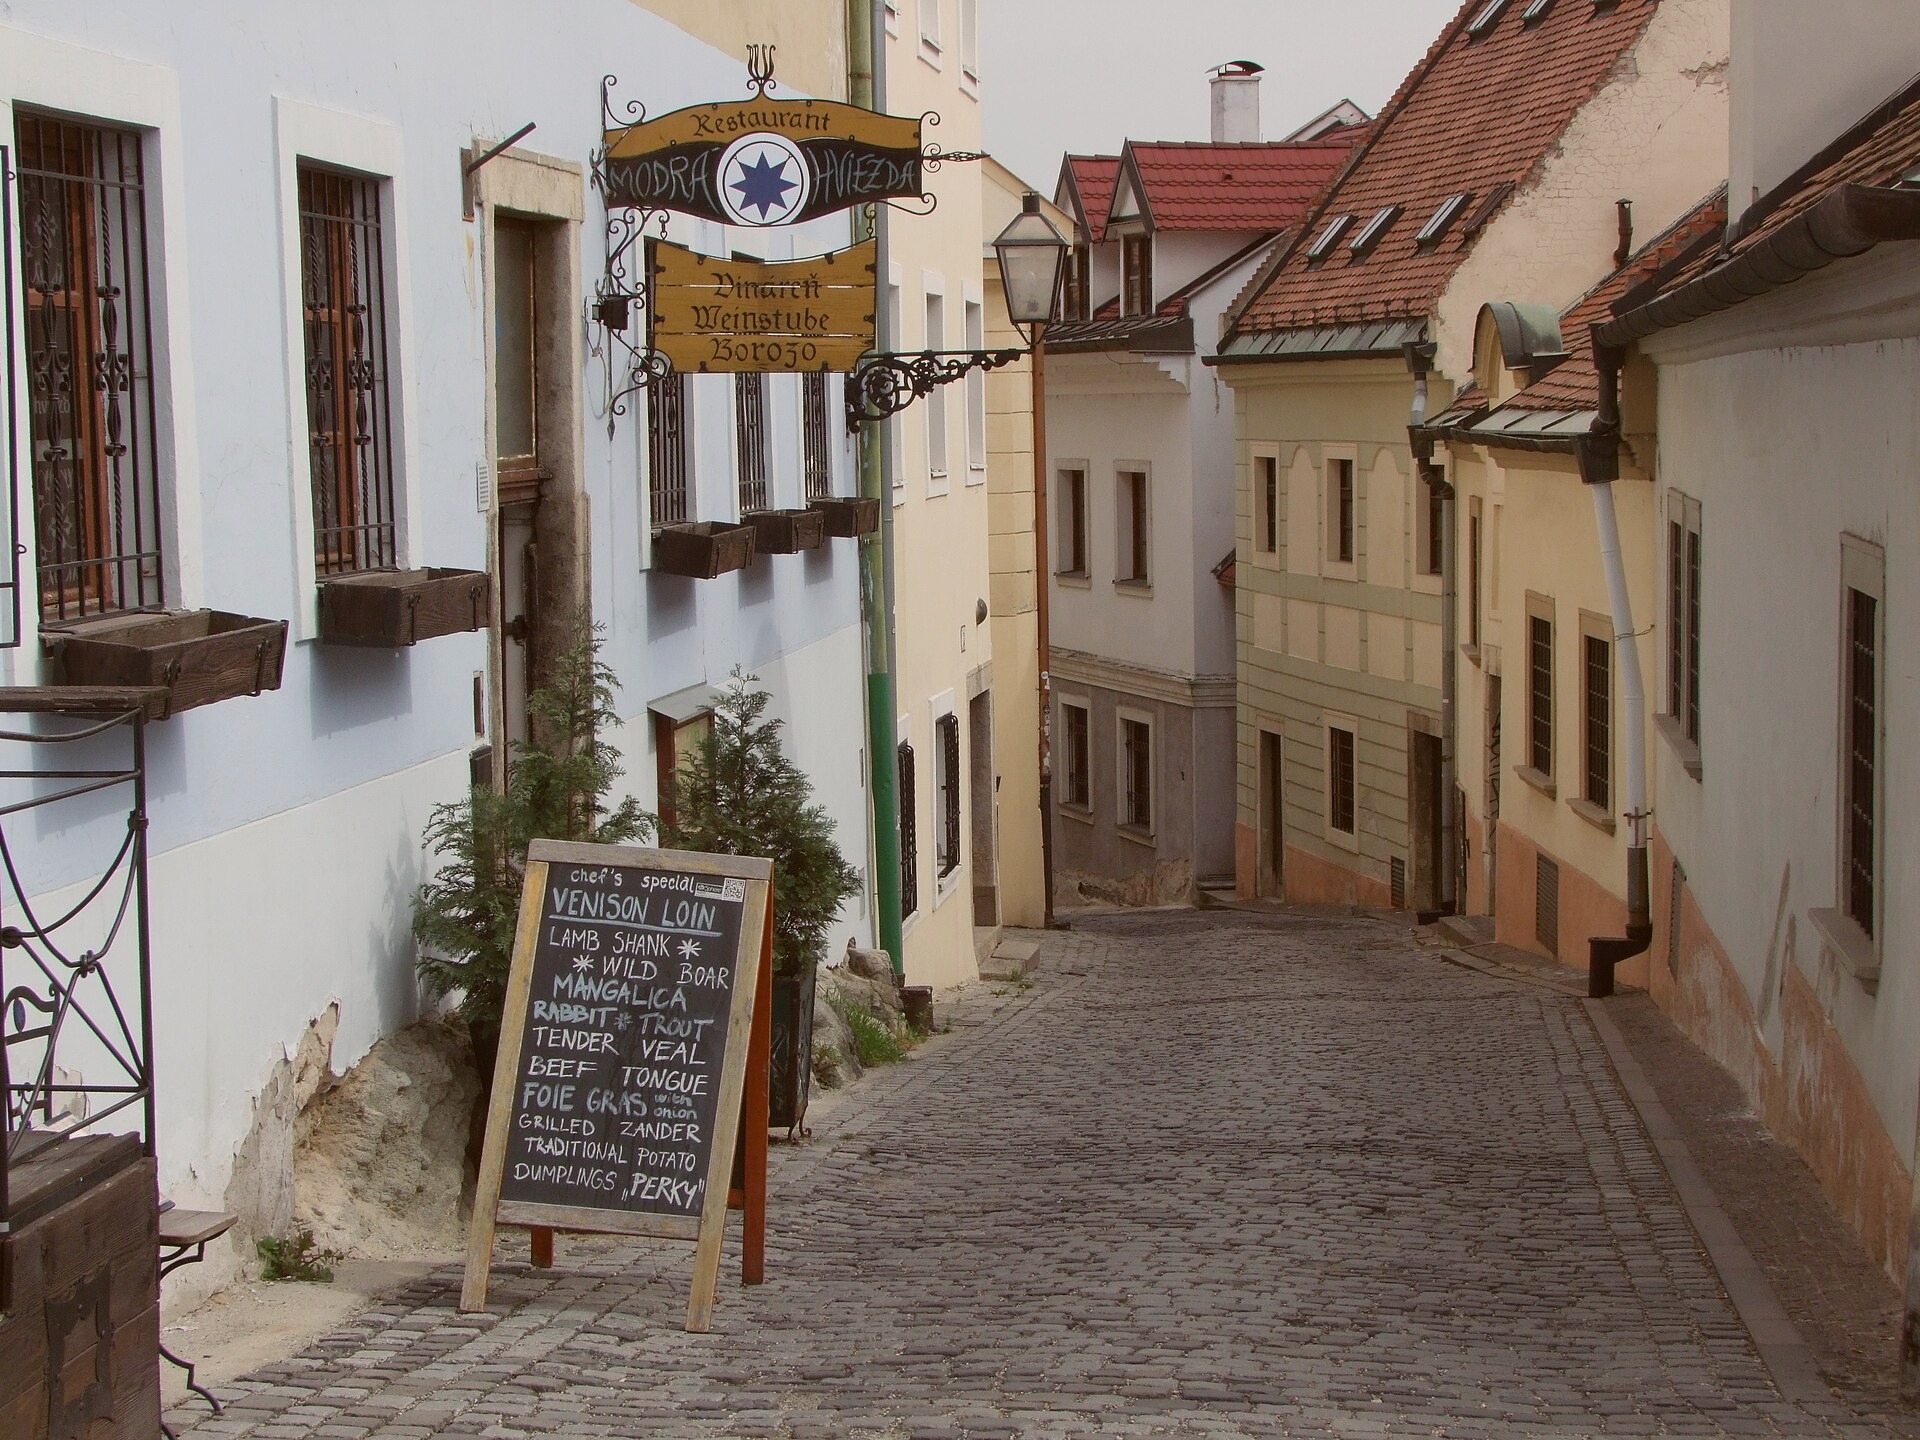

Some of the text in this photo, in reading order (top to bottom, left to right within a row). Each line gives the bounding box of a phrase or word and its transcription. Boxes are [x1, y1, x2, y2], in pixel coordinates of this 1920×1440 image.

[689, 109, 830, 136] Restaurant
[691, 305, 830, 330] Weinstube
[709, 338, 817, 368] Borozo
[570, 868, 695, 893] chef's special
[553, 887, 716, 930] VENISON LOIN
[550, 926, 671, 957] LAMB SHANK
[603, 956, 730, 990] WILD BOAR
[553, 973, 687, 1012] MANGALICA
[533, 1000, 714, 1042] RABBIT TROUT
[532, 1026, 706, 1065] TENDER VEAL
[527, 1055, 708, 1096] BEEF TONGUE
[522, 1082, 648, 1117] FOIE GRAS
[654, 1093, 693, 1107] with
[654, 1106, 697, 1120] onion
[518, 1113, 701, 1143] GRILLED ZANDER
[524, 1136, 696, 1173] TRADITIONAL POTATO
[513, 1163, 618, 1191] DUMPLINGS
